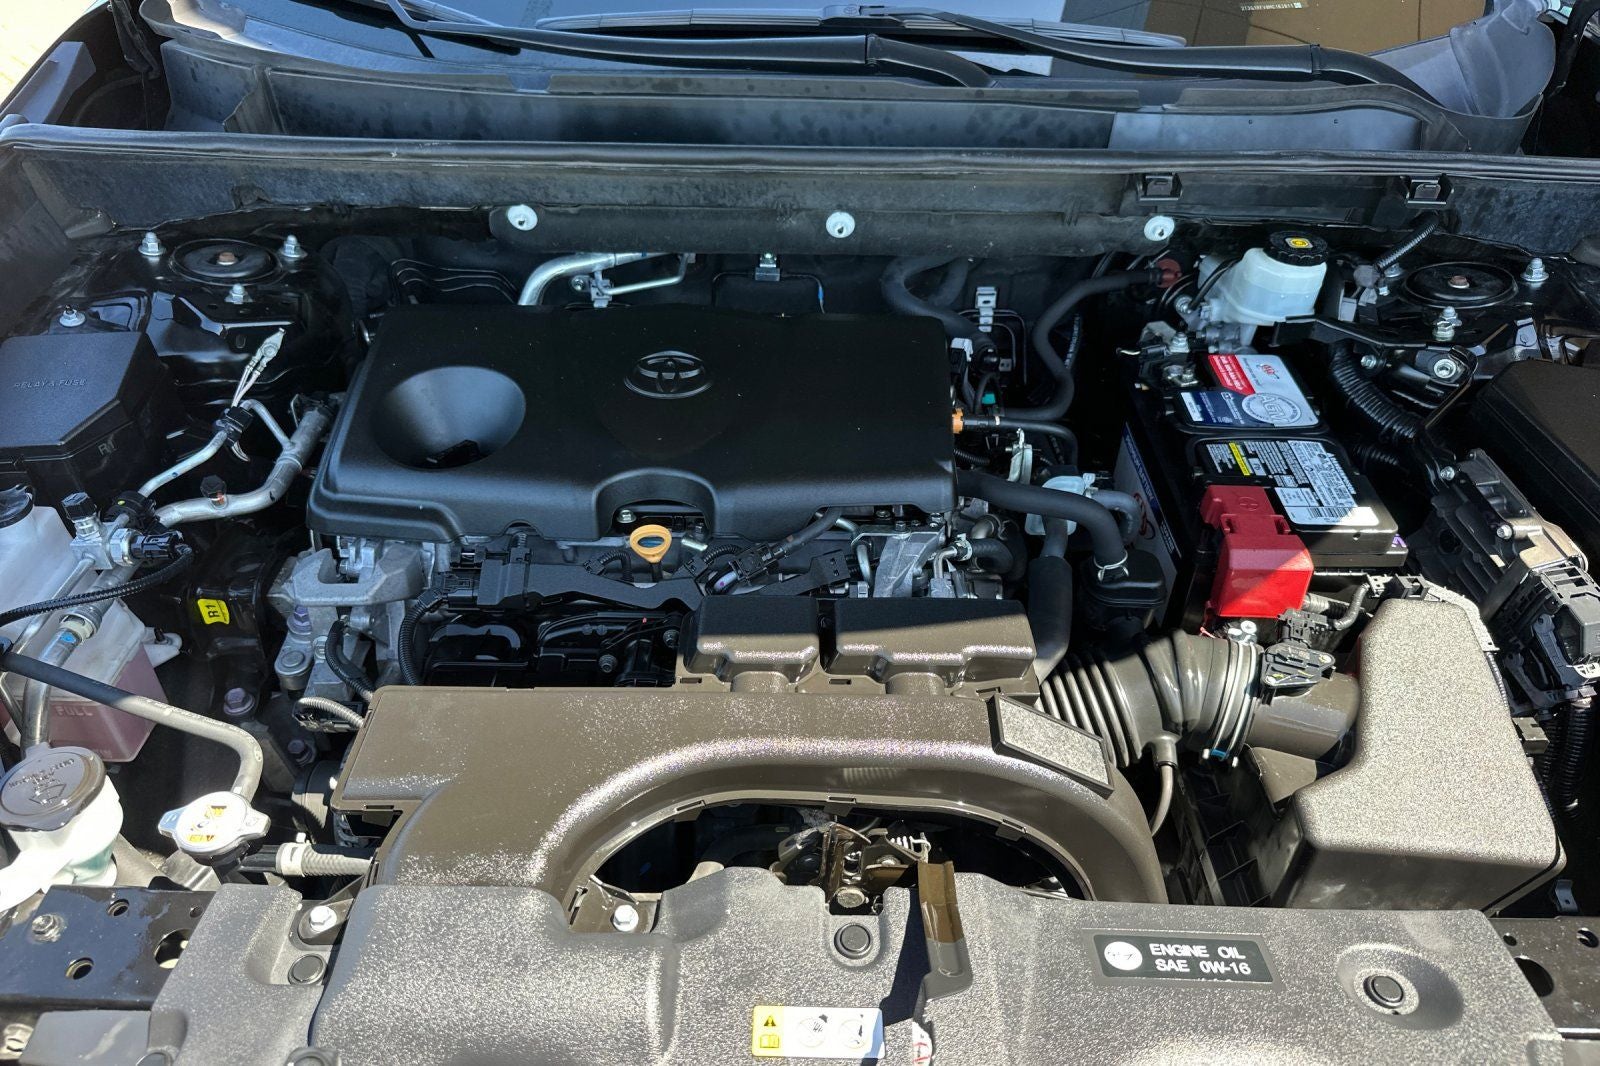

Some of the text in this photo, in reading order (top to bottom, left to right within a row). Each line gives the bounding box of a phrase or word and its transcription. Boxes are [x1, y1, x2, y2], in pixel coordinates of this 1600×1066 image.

[58, 379, 88, 387] FUSE
[1261, 396, 1290, 422] AGM
[205, 604, 221, 618] R1
[55, 705, 94, 717] FULL
[1149, 943, 1247, 960] ENGINE OIL
[1154, 959, 1252, 975] SAE 0W-16
